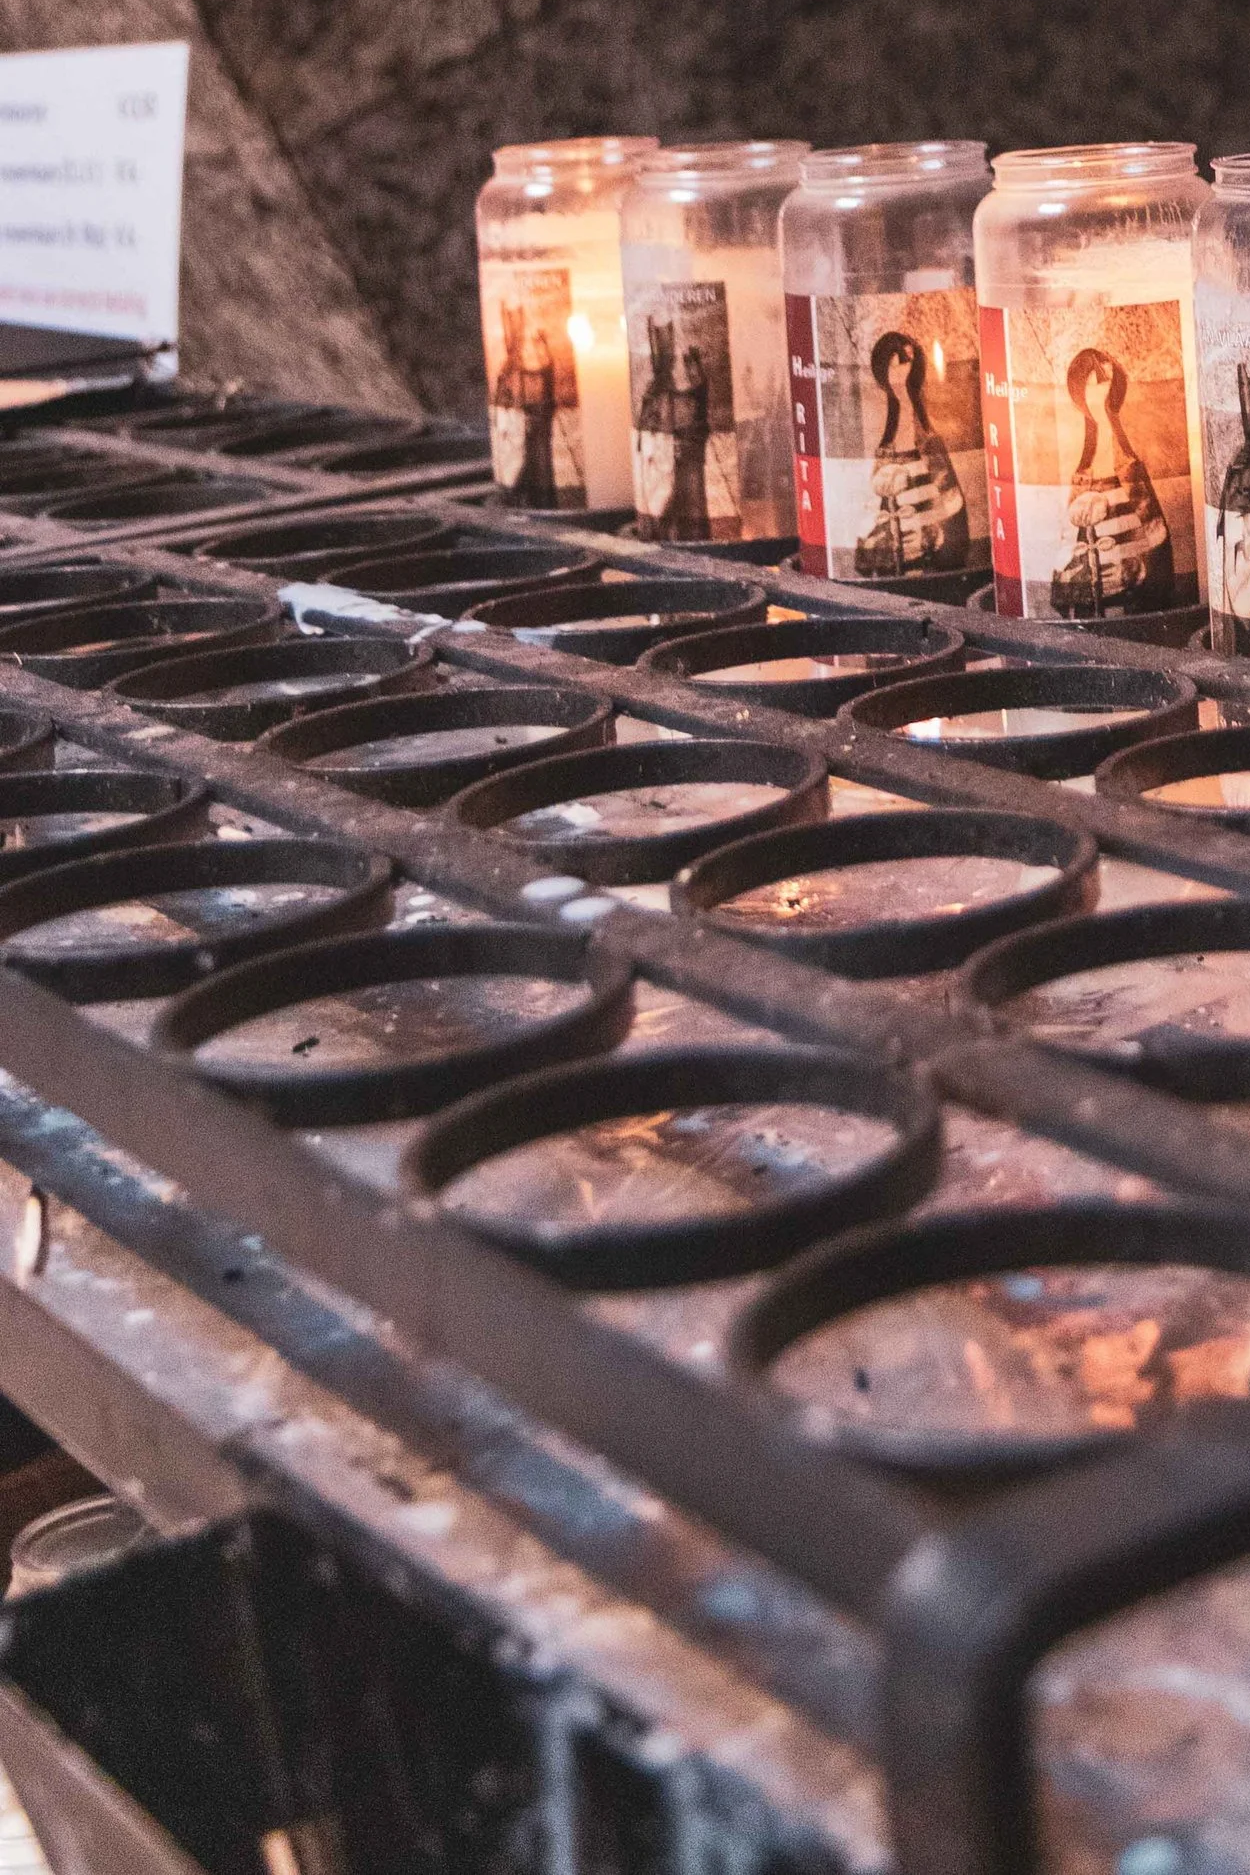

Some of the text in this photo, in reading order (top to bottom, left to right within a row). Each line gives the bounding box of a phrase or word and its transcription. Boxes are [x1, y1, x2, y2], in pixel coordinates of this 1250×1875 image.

[985, 372, 1029, 402] Heilge
[796, 402, 812, 511] RITA
[990, 422, 1006, 541] RITA
